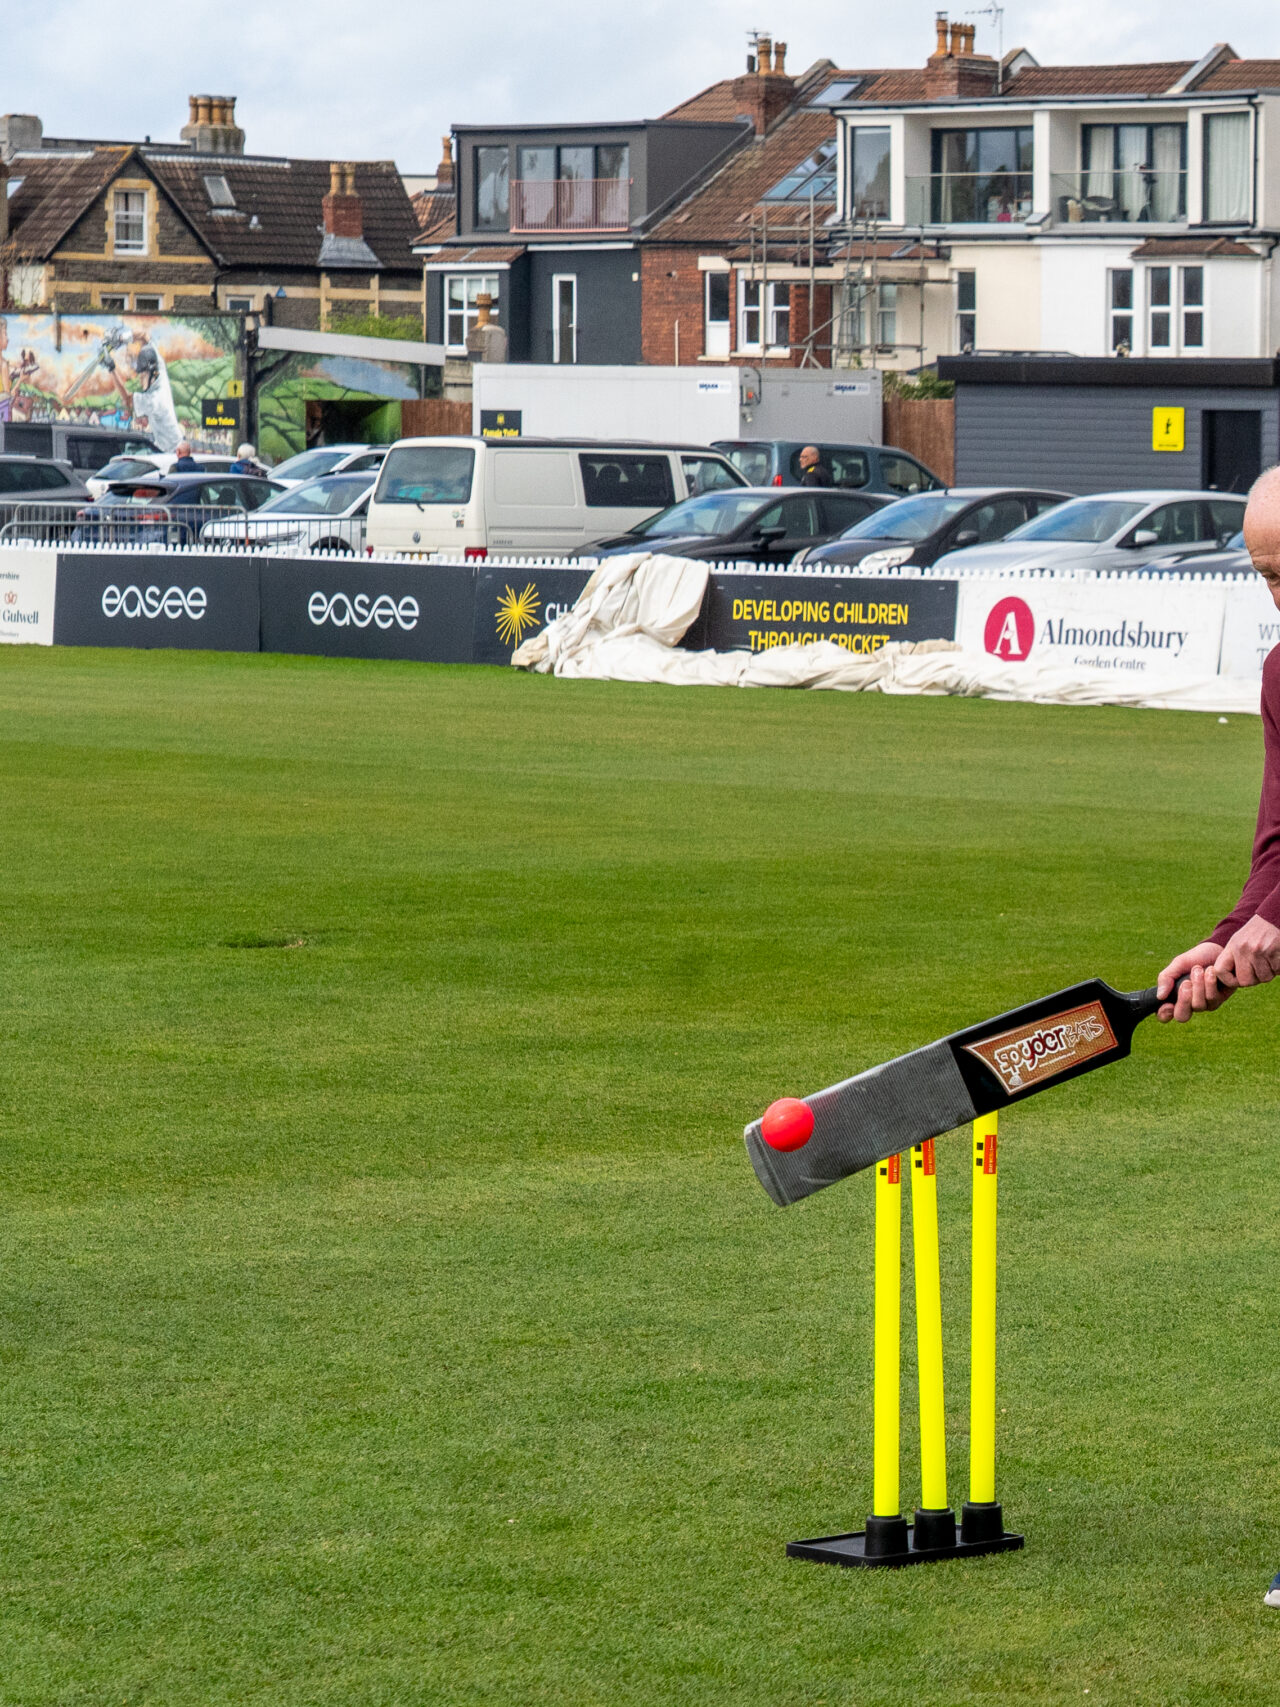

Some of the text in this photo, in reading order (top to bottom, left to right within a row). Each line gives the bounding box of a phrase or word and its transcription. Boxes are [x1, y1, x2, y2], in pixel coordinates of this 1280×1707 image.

[2, 609, 39, 624] Gulwell
[102, 585, 207, 620] easee
[308, 591, 420, 630] easee
[732, 599, 909, 625] DEVELOPING CHILDREN
[1039, 617, 1189, 657] Almondsbury
